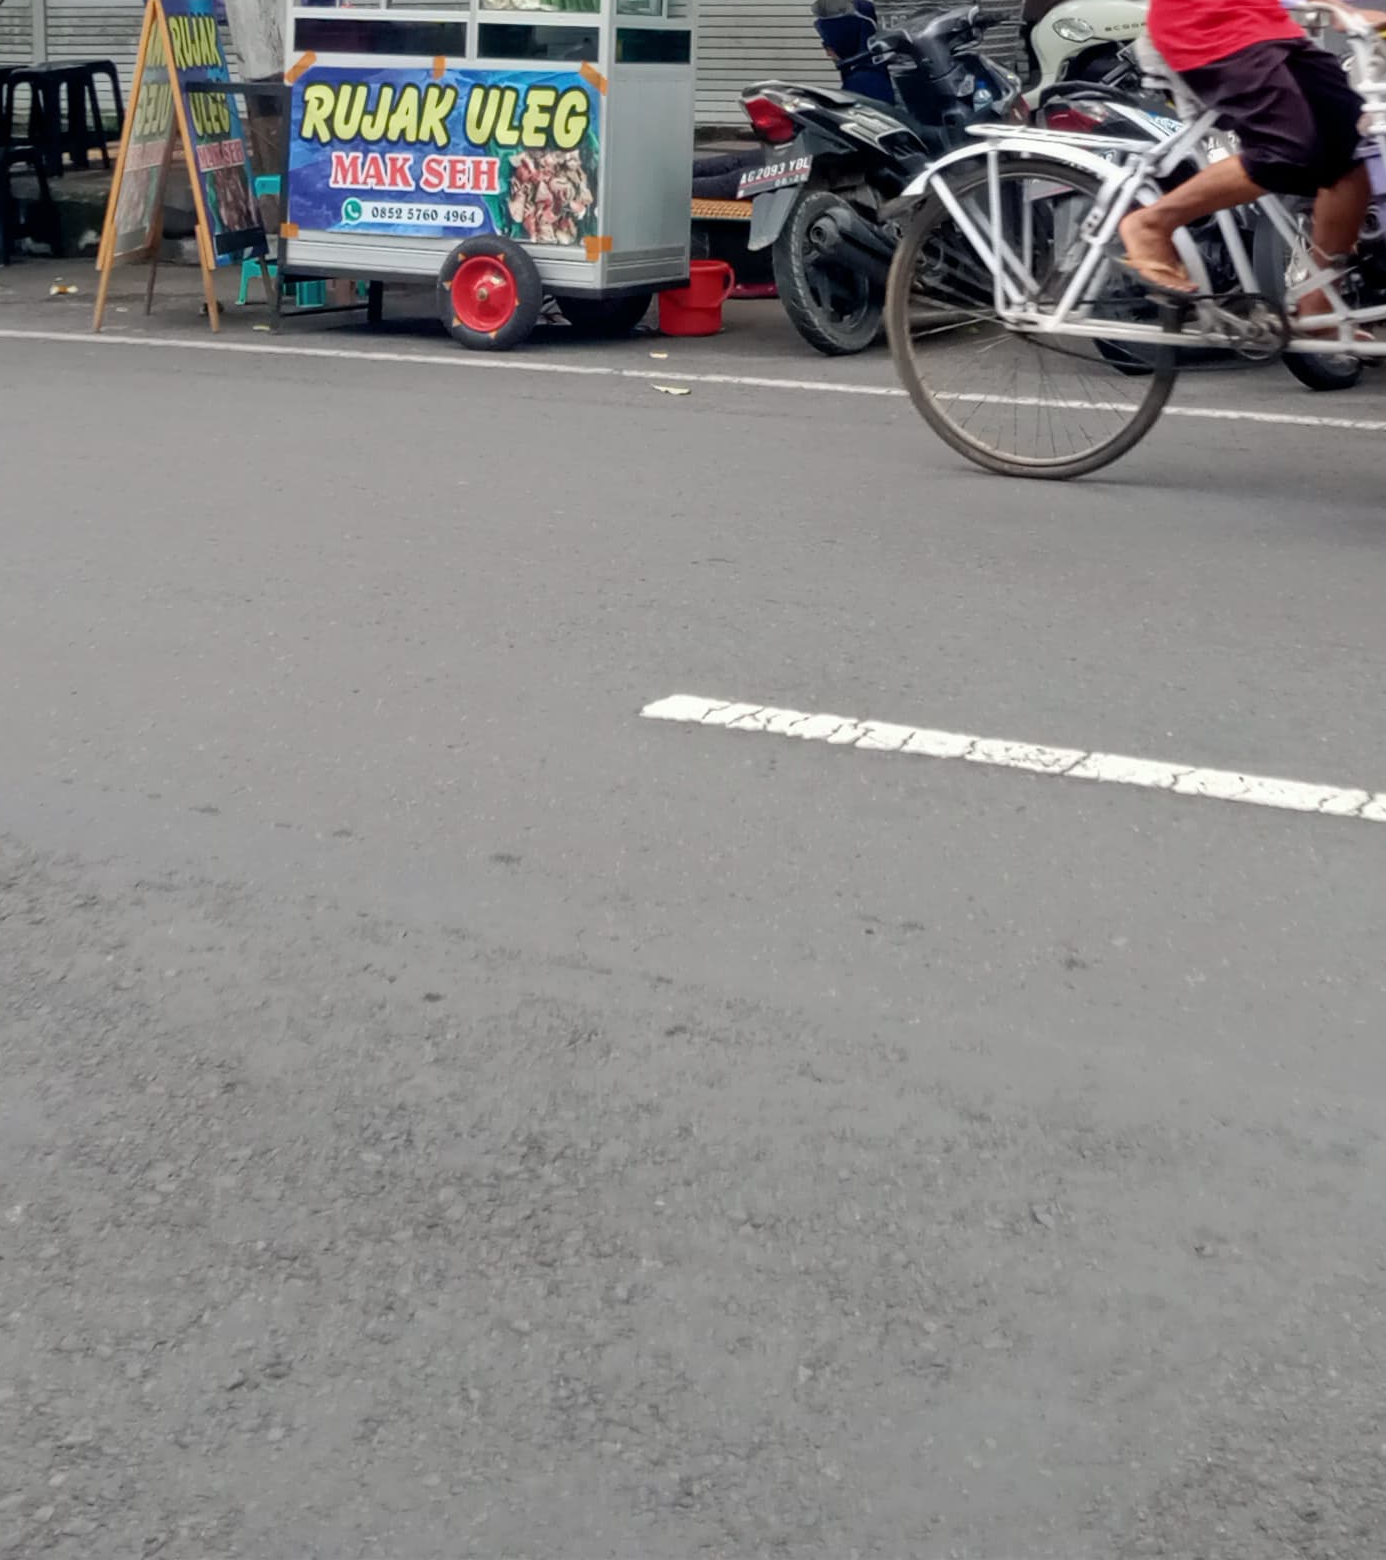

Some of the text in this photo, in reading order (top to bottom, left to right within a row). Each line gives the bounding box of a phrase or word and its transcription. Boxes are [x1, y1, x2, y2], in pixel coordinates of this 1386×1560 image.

[300, 83, 589, 149] RUJAK ULEG
[330, 152, 500, 194] MAK SEH
[371, 206, 476, 224] 0852 5760 4964
